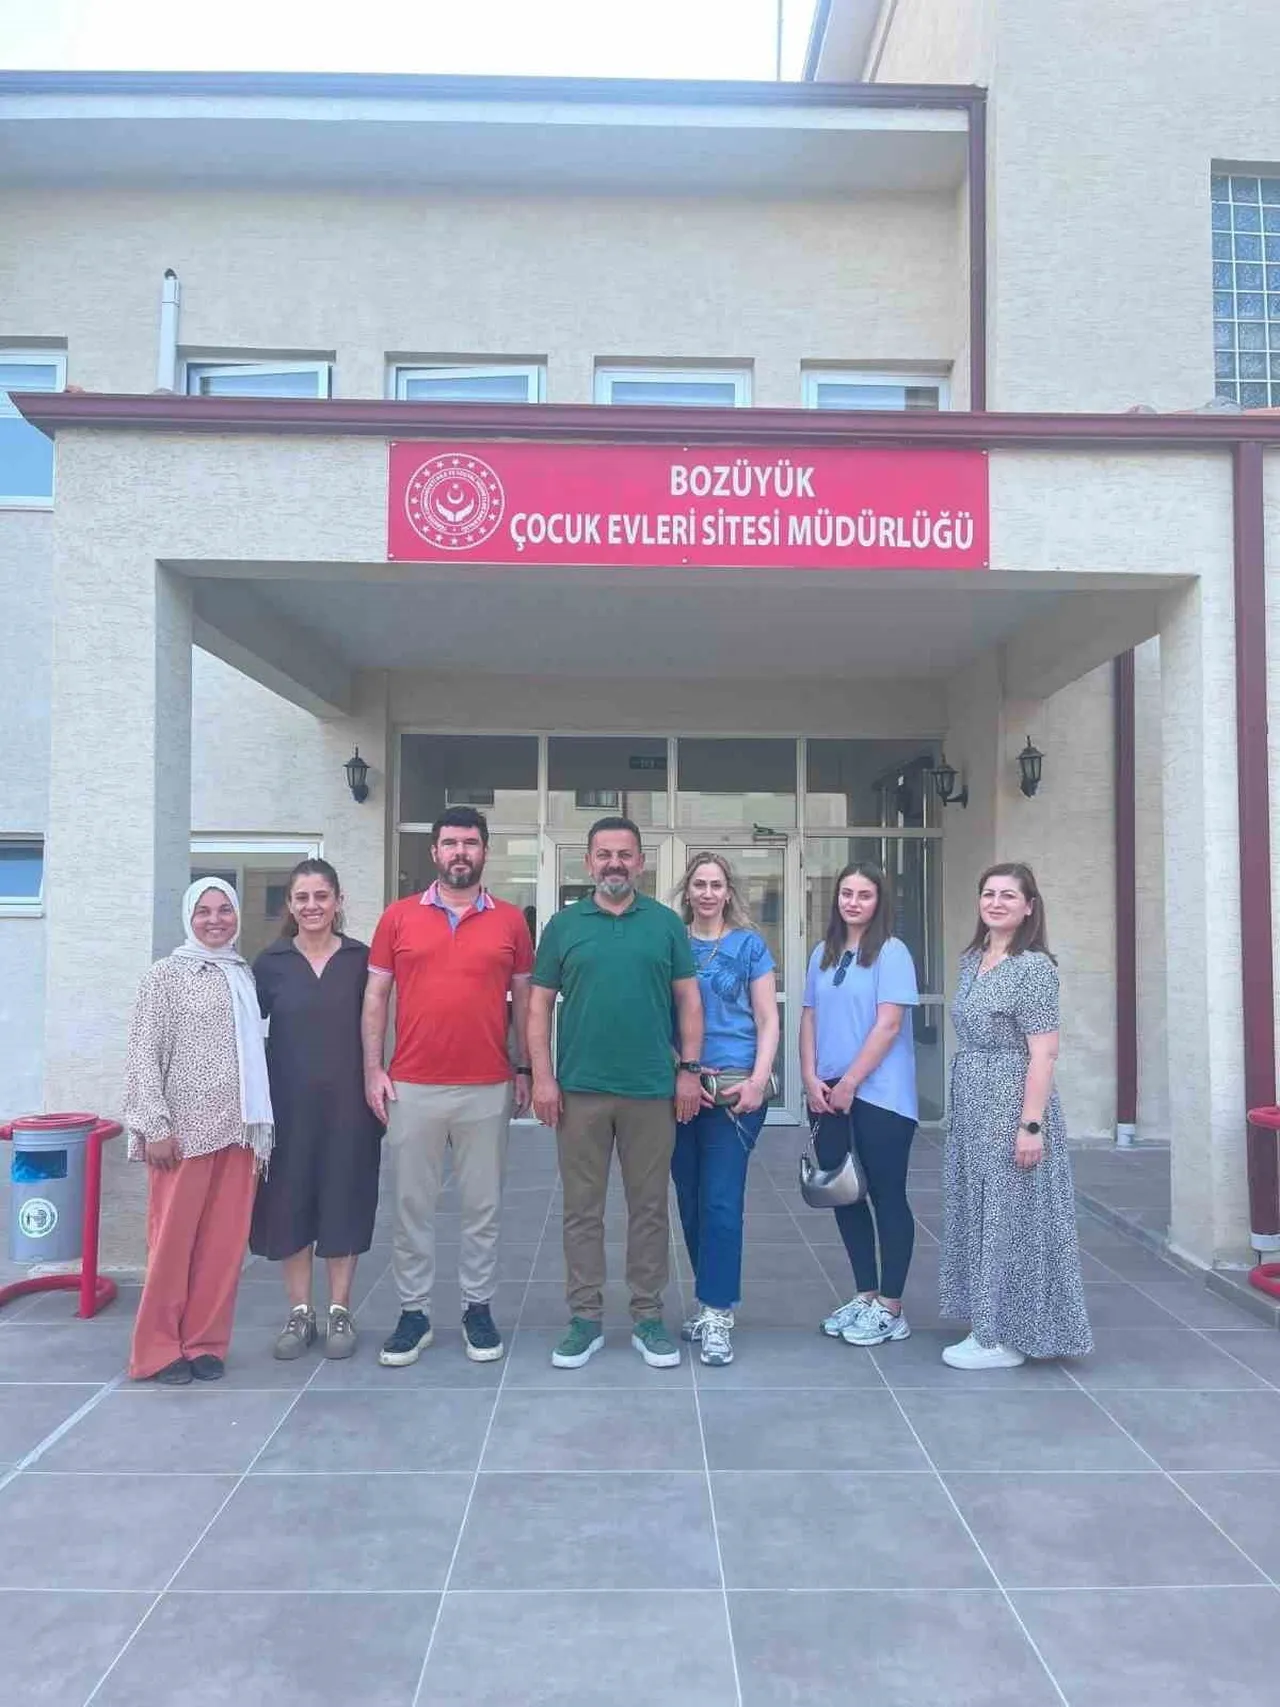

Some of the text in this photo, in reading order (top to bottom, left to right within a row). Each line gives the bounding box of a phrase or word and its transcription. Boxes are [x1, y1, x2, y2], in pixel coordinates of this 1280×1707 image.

[670, 459, 815, 497] BOZÜYÜK
[510, 508, 974, 550] ÇOCUK EVLERİ SİTESİ MÜDÜRLÜĞÜ
